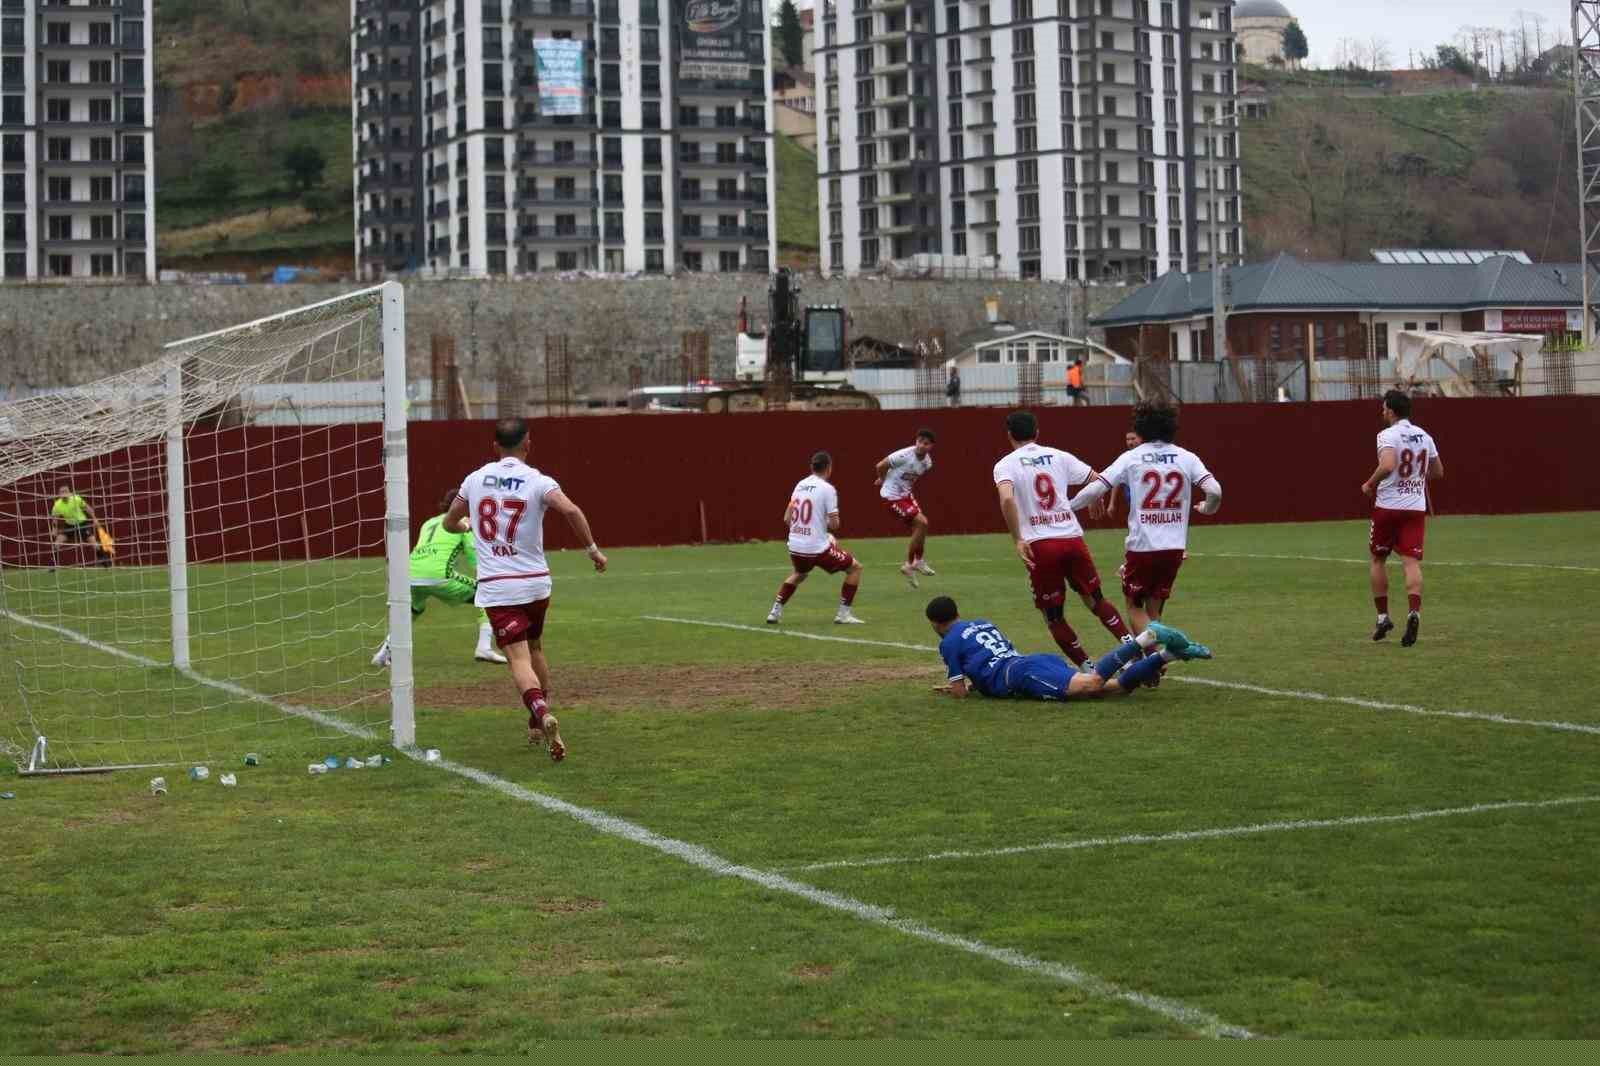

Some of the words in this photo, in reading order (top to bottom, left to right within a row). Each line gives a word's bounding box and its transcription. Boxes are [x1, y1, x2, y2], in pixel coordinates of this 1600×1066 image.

[1398, 448, 1428, 478] 81
[482, 474, 526, 491] DMT
[1033, 472, 1057, 511] 9
[1141, 469, 1185, 510] 22
[478, 496, 528, 544] 87
[1140, 512, 1183, 524] EMRULLAH
[491, 545, 518, 557] KAL
